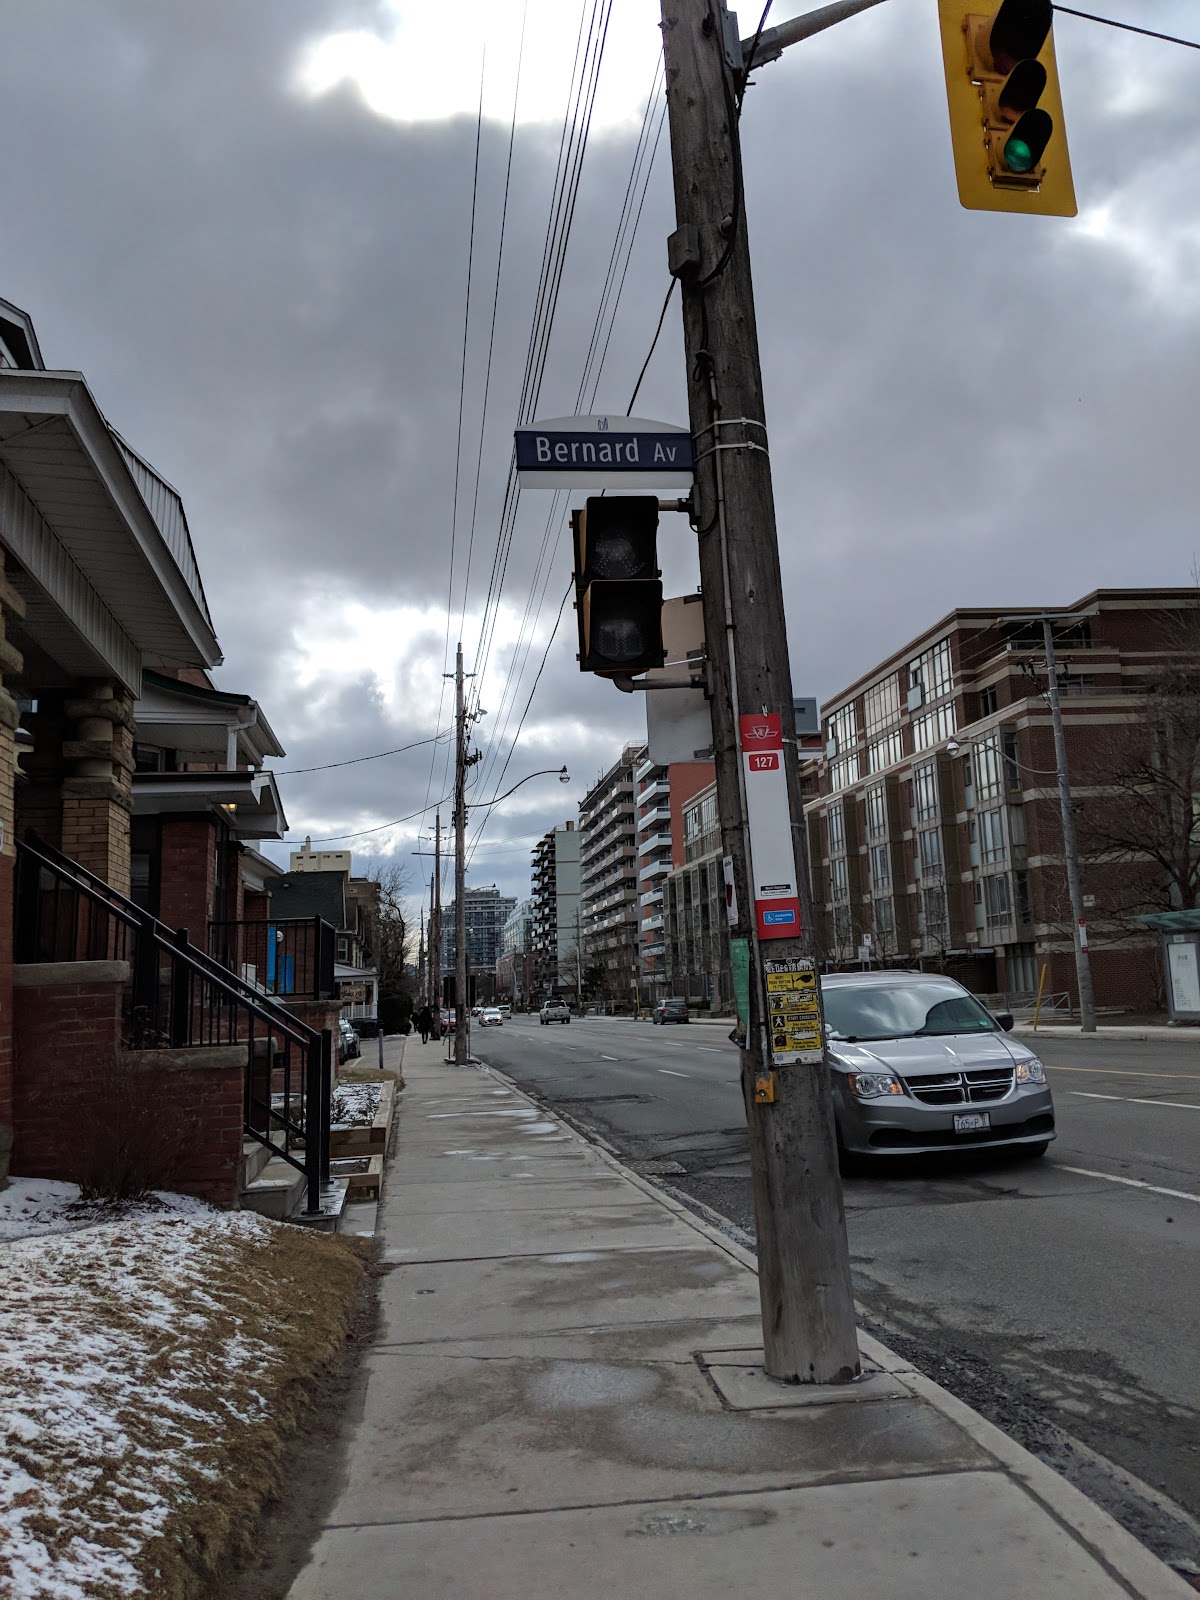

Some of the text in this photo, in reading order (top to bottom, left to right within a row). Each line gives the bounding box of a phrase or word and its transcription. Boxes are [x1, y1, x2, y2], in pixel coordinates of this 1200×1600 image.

[535, 436, 678, 463] Bernard Av
[754, 756, 773, 768] 127
